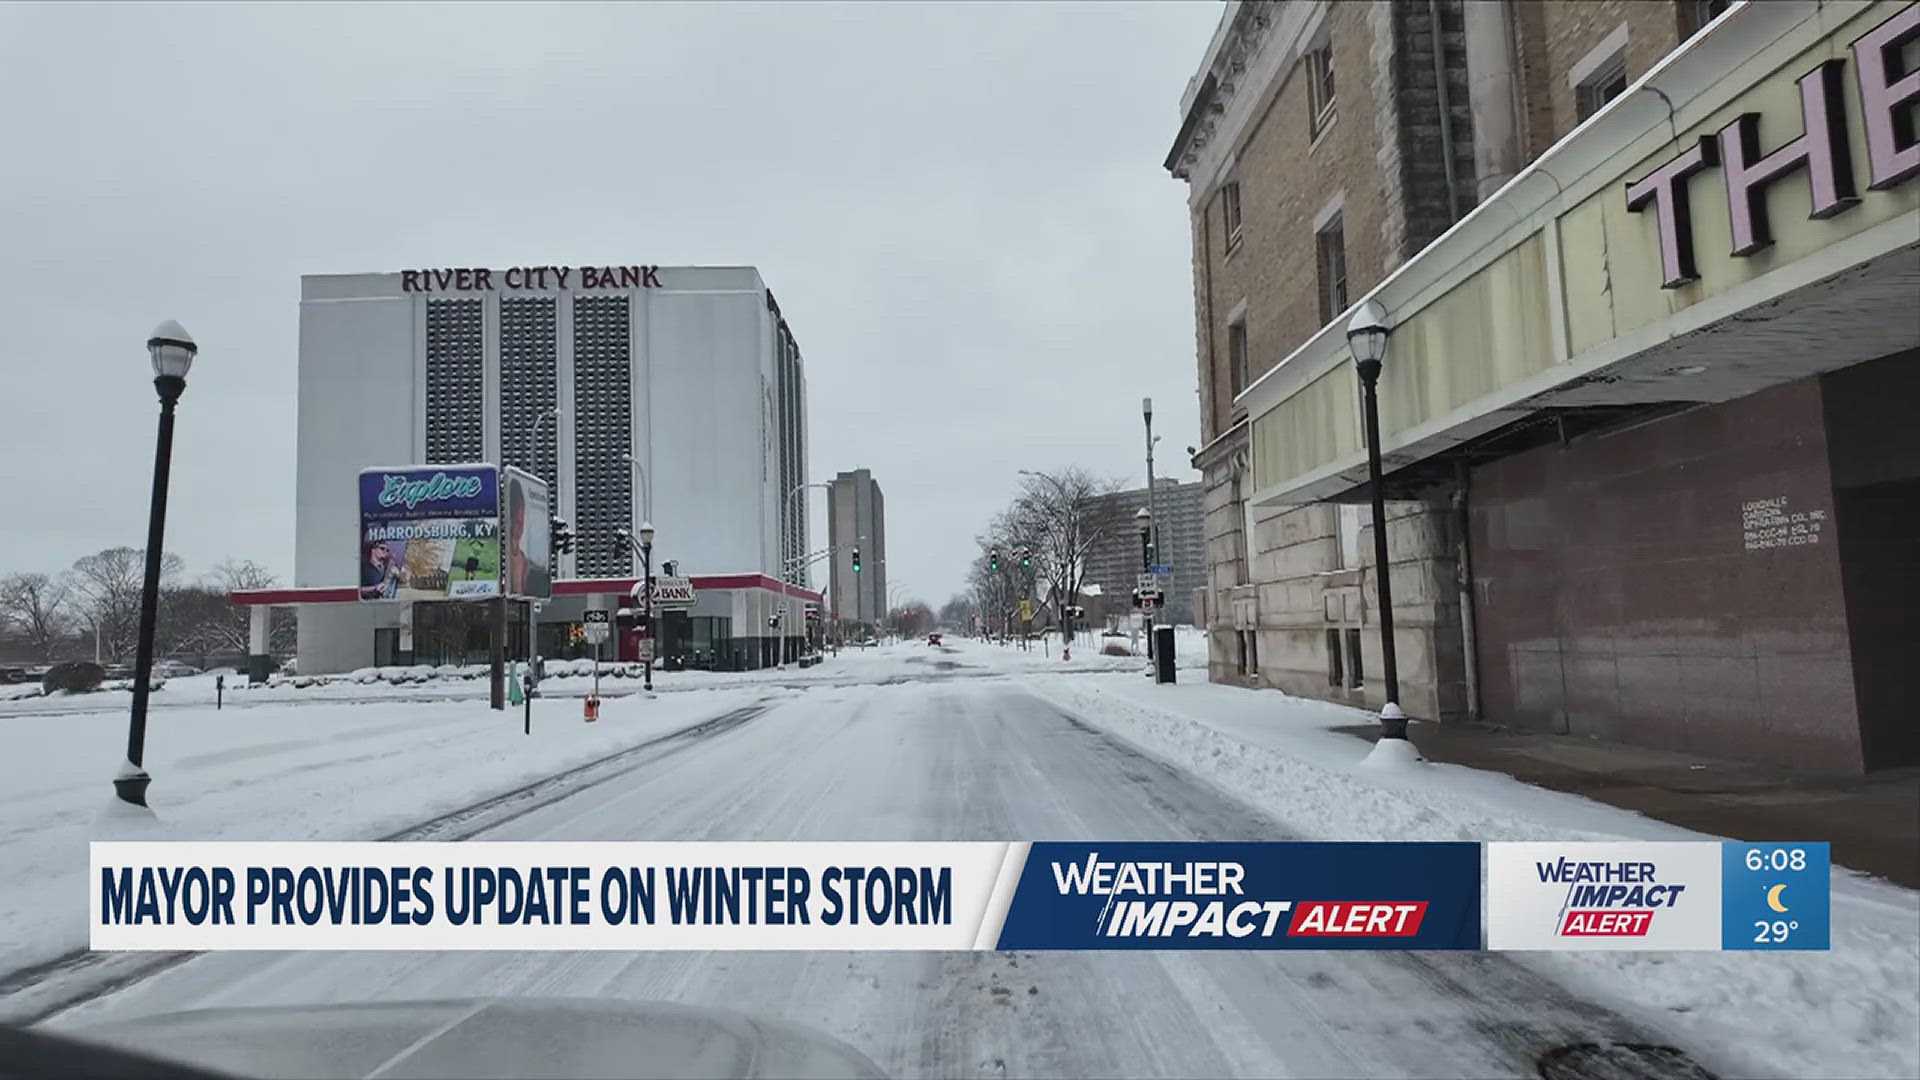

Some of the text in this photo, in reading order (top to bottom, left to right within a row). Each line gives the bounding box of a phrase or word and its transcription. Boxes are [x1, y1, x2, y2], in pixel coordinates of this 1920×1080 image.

[401, 265, 663, 292] RIVER CITY BANK
[378, 472, 482, 510] Explore
[368, 522, 493, 541] HARRODSBURG, KY
[661, 587, 690, 599] BANK
